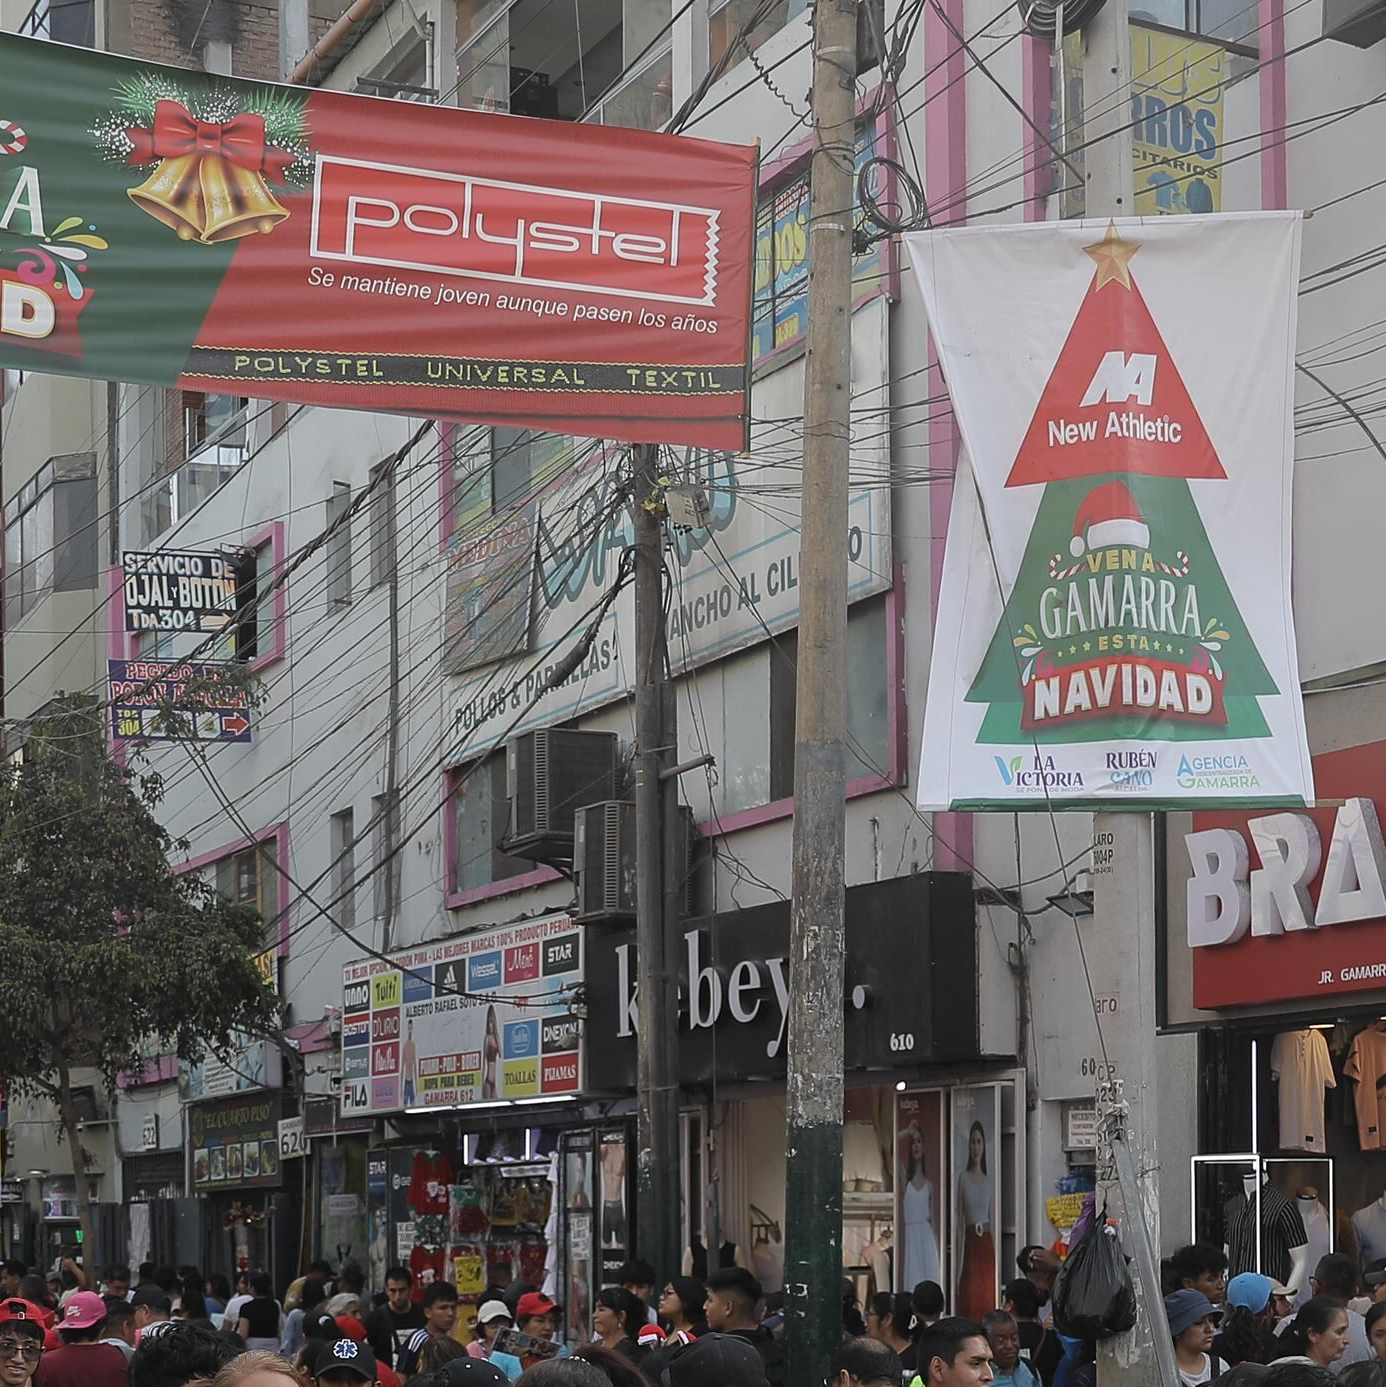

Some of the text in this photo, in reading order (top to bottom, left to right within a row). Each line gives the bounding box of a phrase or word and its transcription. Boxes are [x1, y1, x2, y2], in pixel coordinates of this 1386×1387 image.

[307, 267, 718, 335] Se mantiene joven aunque pasen los años
[233, 354, 722, 389] POLYSTEL UNIVERSAL TEXTIL
[1048, 412, 1182, 446] New Athletic
[124, 553, 235, 579] SERVICIO DE
[1086, 550, 1156, 573] VEN A
[125, 574, 173, 607] OJAL
[171, 586, 177, 598] Y
[669, 572, 761, 641] ANCHO AL
[1039, 574, 1202, 640] GAMARRA
[1098, 636, 1149, 651] ESTA
[1033, 663, 1213, 720] NAVIDAD
[455, 688, 507, 735] POLLOS
[1034, 756, 1055, 770] LA
[1106, 749, 1157, 769] RUBÉN
[1177, 753, 1248, 776] AGENCIA
[1110, 769, 1153, 787] CANO
[1177, 775, 1260, 789] GAMARRA
[548, 944, 573, 962] STAR
[1318, 970, 1334, 984] JR.
[406, 1001, 433, 1018] ALBERTO
[435, 997, 458, 1013] RAFAEL
[889, 1032, 915, 1052] 610
[505, 1070, 536, 1084] TOALLAS
[344, 1084, 370, 1108] FILA
[425, 1090, 474, 1105] GAMARRA 612
[143, 1127, 156, 1145] 622
